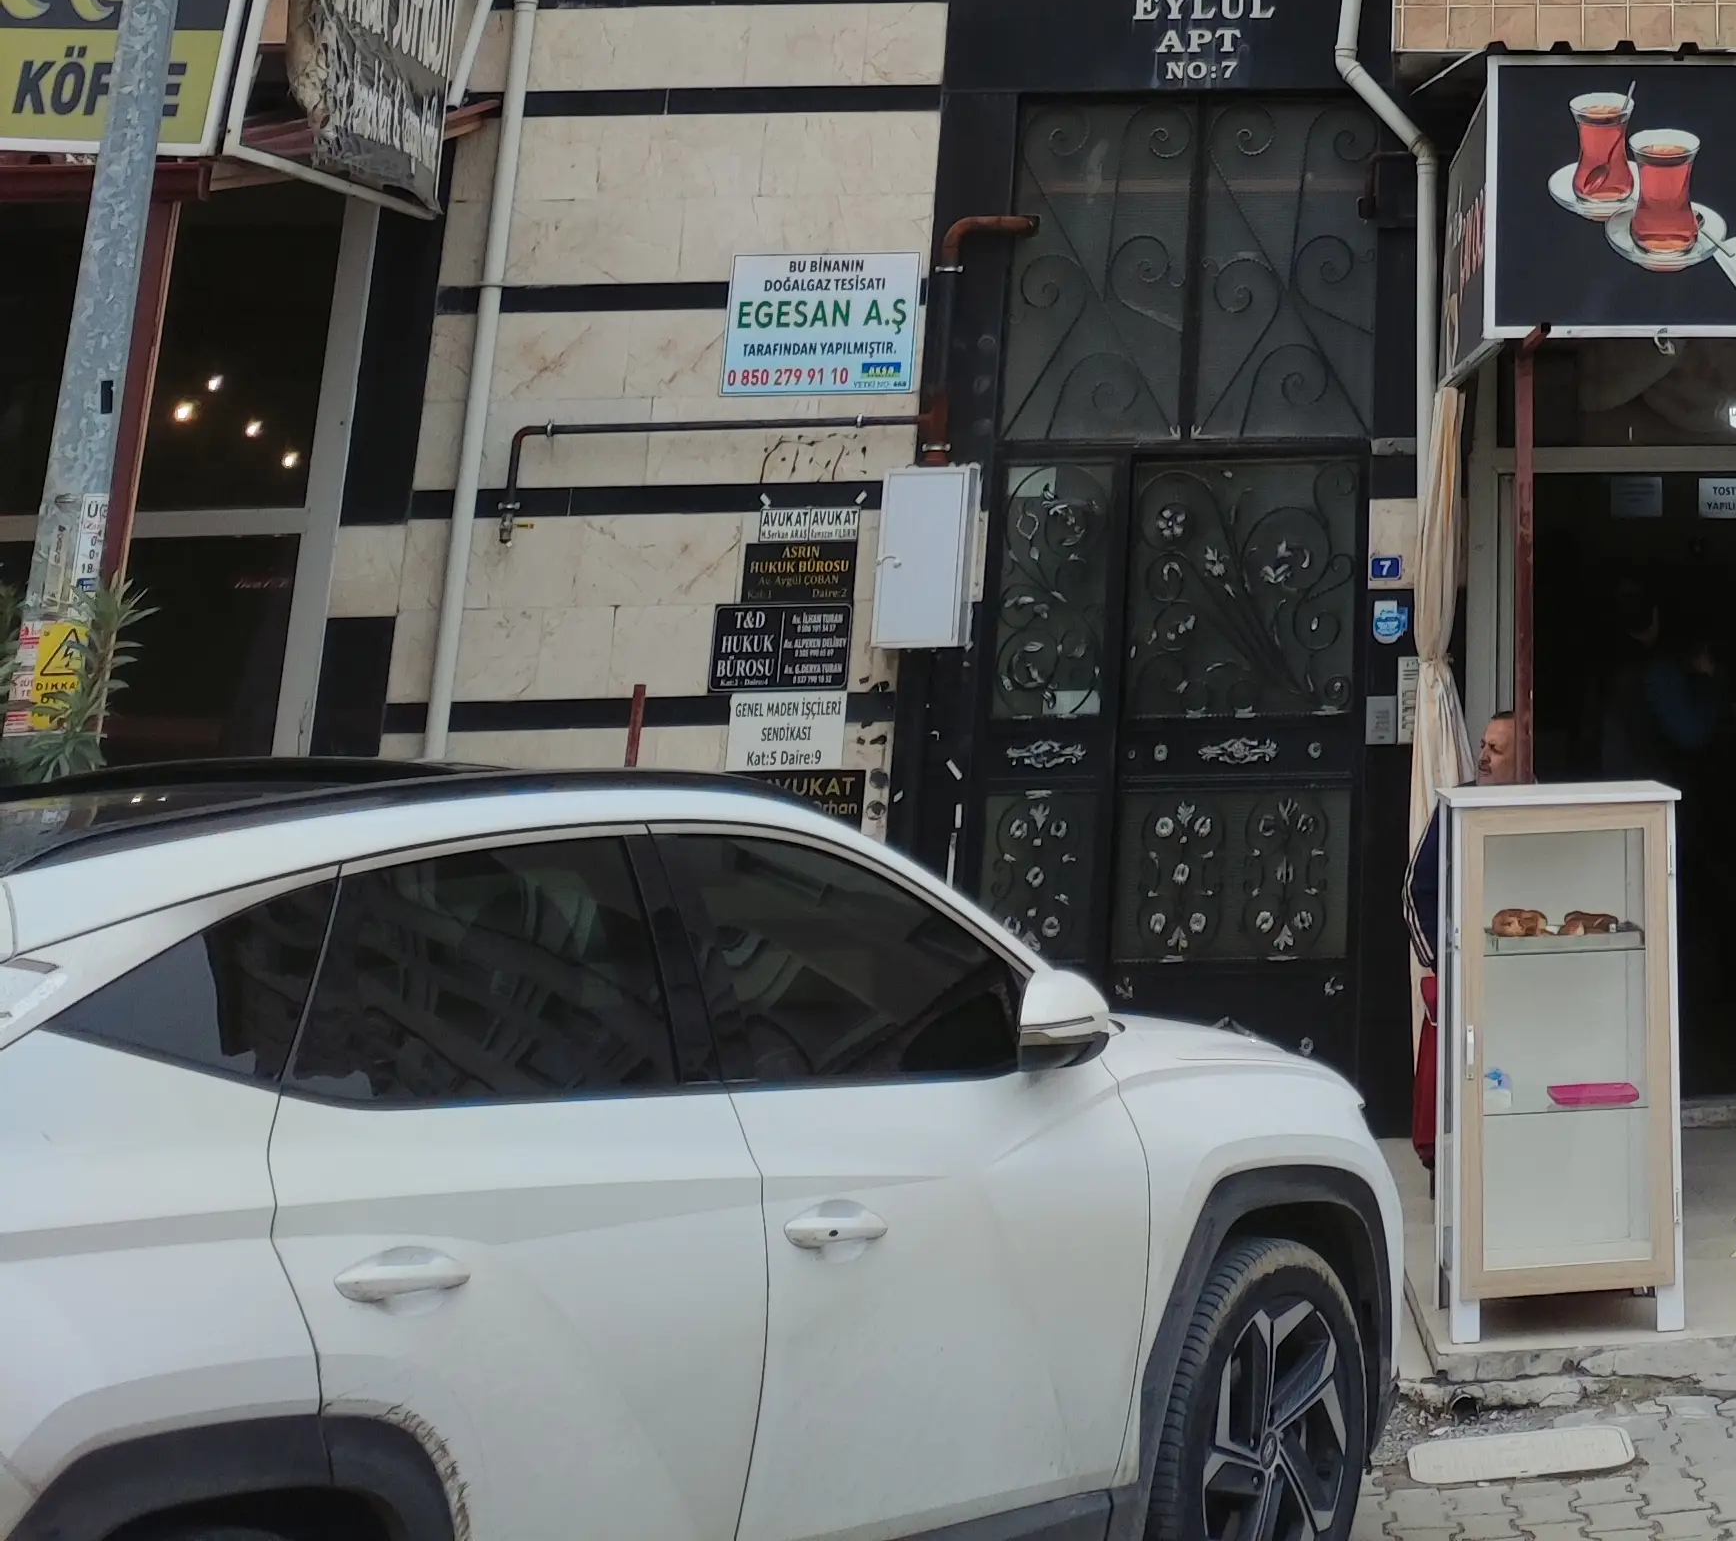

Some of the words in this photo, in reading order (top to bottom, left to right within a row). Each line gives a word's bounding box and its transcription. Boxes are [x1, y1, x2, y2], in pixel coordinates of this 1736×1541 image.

[1156, 29, 1241, 53] APT
[1165, 61, 1238, 80] NO:7
[12, 45, 187, 117] KÖFE
[789, 261, 806, 273] BU
[810, 257, 864, 273] BİNANIN
[764, 276, 832, 292] DOĞALGAZ
[834, 275, 885, 291] TESİSATI
[737, 300, 850, 329] EGESAN
[863, 298, 907, 334] A.Ş
[743, 342, 817, 357] TARAFINDAN
[819, 341, 897, 359] YAPILMIŞTIR.
[728, 370, 736, 386] 0
[741, 369, 769, 385] 850
[774, 368, 802, 385] 279
[807, 368, 824, 385] 91
[831, 368, 848, 384] 10
[1712, 487, 1736, 495] TOST
[763, 511, 808, 526] AVUKAT
[812, 511, 857, 525] AVUKAT
[782, 545, 820, 558] ASRIN
[750, 561, 796, 574] HUKUK
[799, 558, 849, 573] BÜROSU
[1379, 560, 1392, 575] 7
[804, 575, 839, 586] ÇOBAN
[735, 611, 766, 629] T&D
[721, 635, 775, 653] HUKUK
[716, 655, 775, 677] BÜROSU
[736, 703, 763, 717] GENEL
[767, 702, 799, 717] MADEN
[801, 697, 841, 720] İŞÇİLERİ
[761, 723, 811, 741] SENDİKASI
[747, 751, 776, 766] Kat:5
[781, 750, 821, 765] Daire:9
[767, 777, 855, 796] VUKAT
[813, 797, 858, 815] rhan
